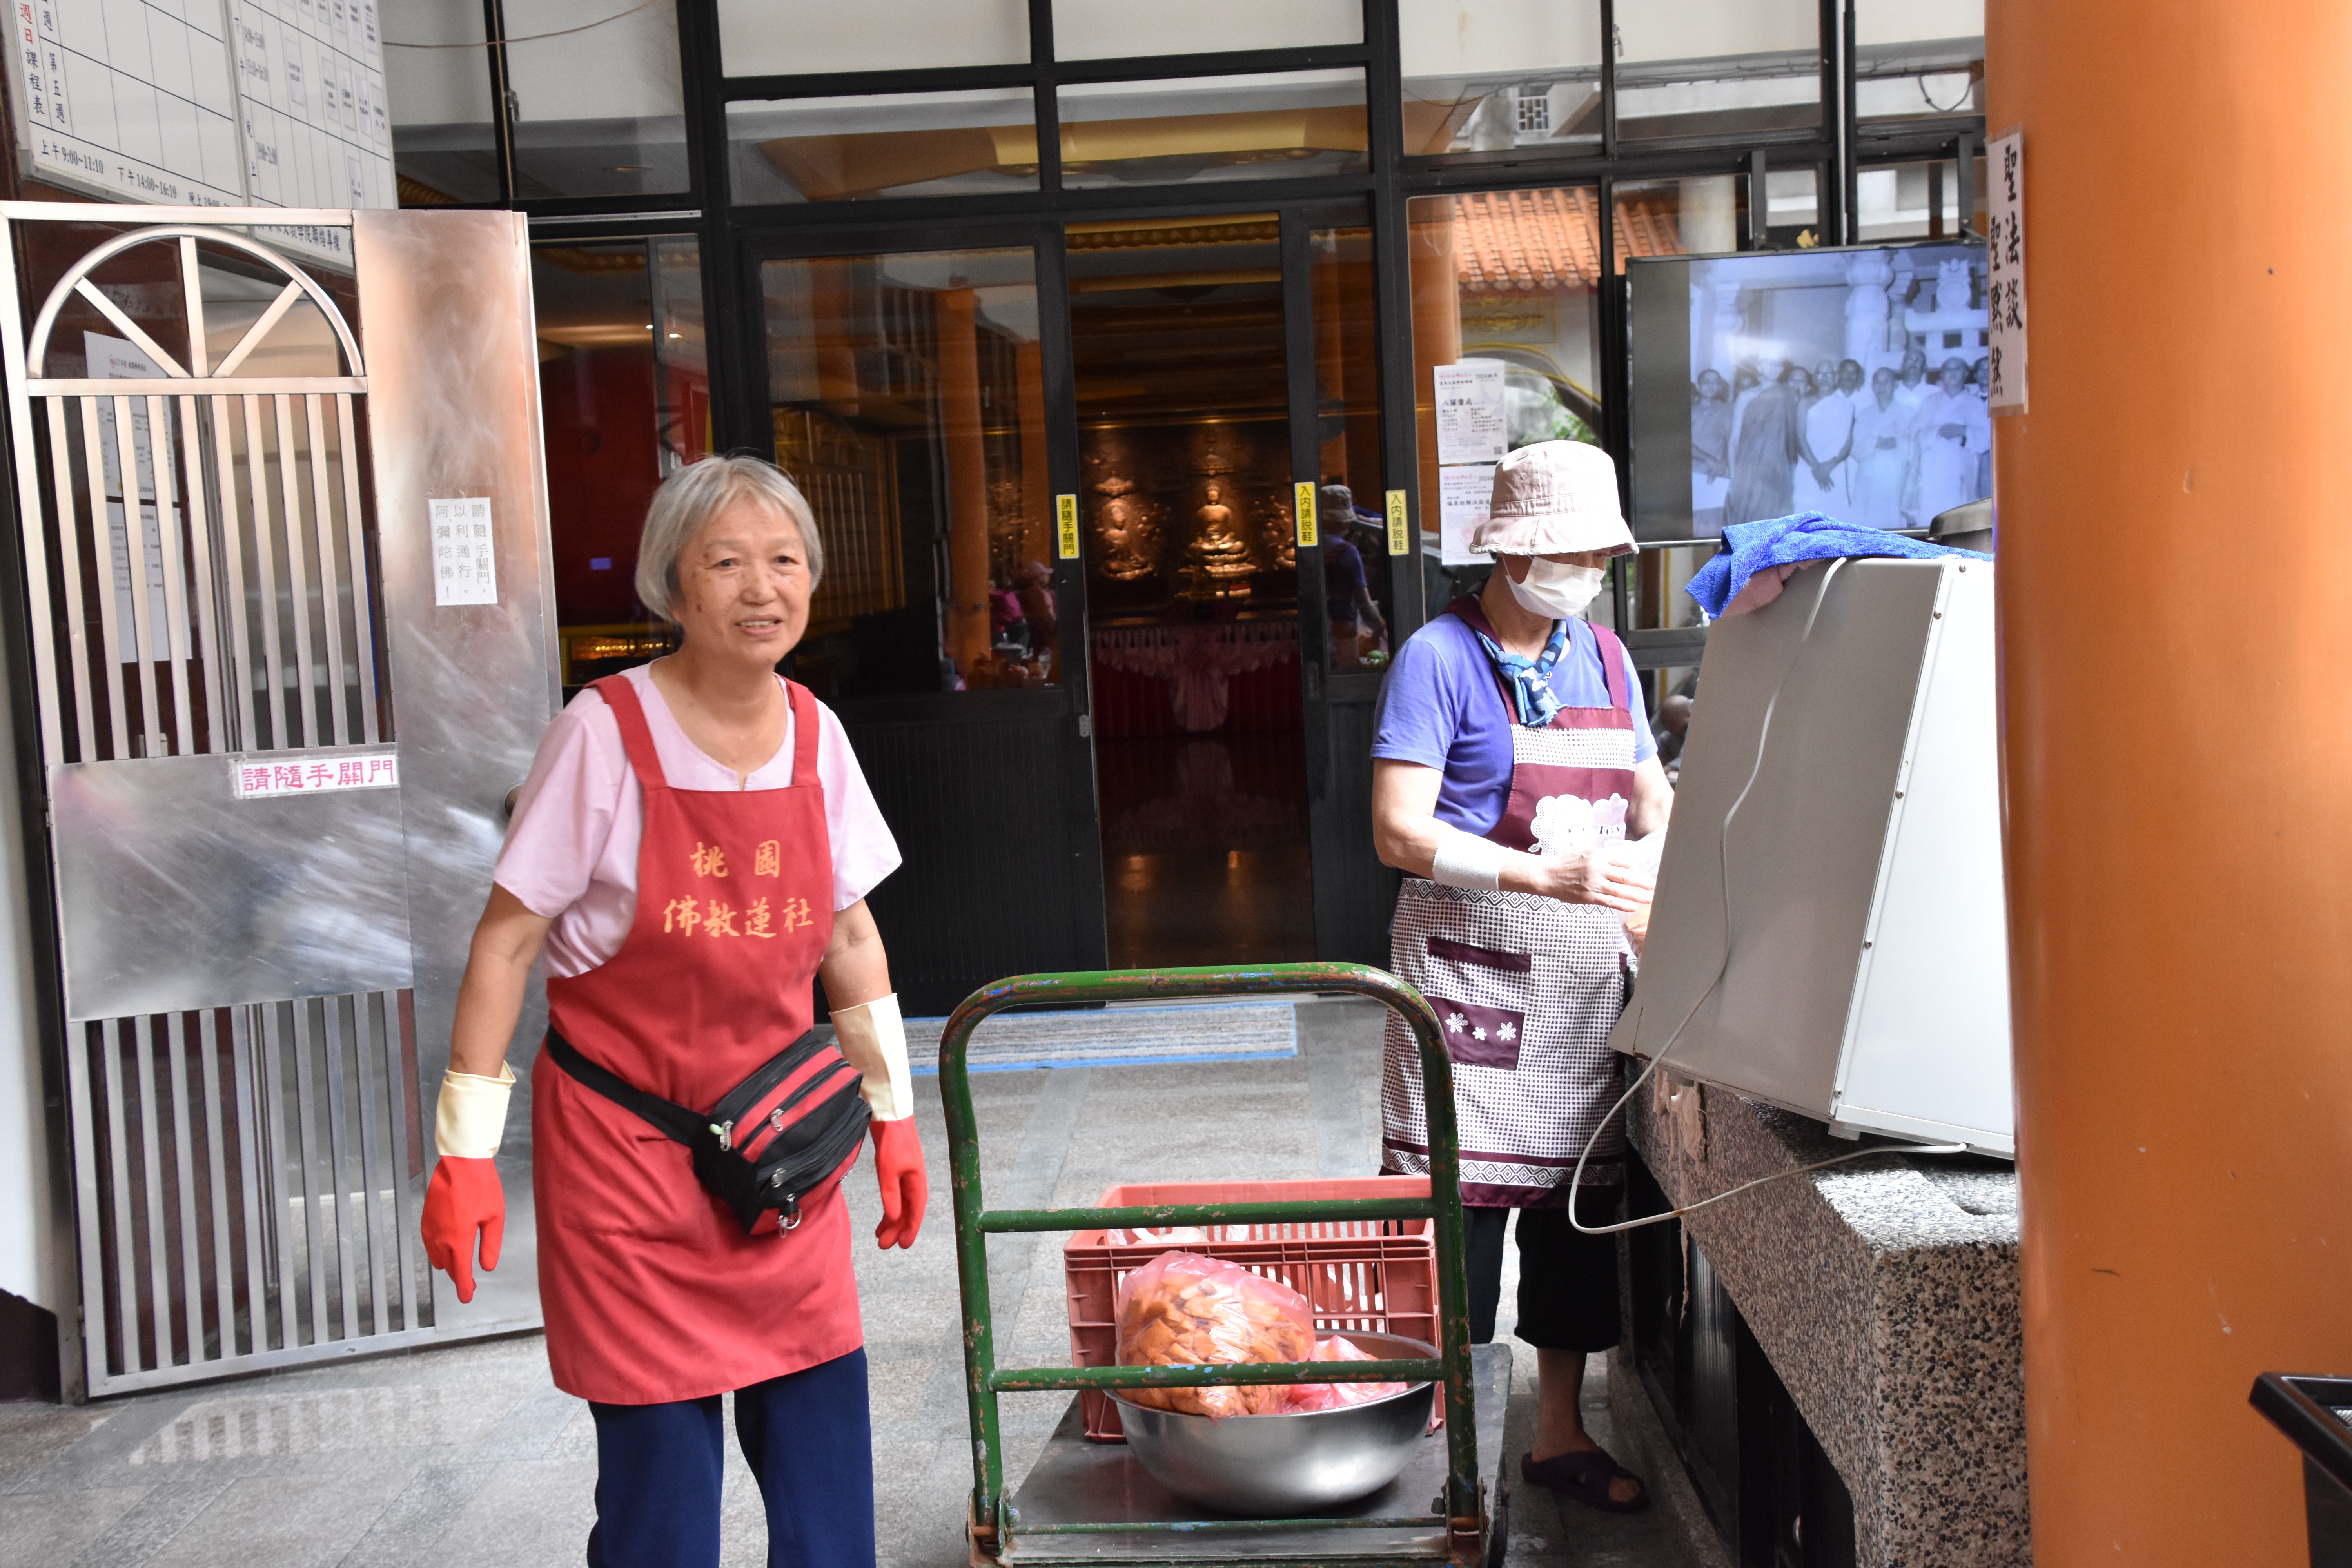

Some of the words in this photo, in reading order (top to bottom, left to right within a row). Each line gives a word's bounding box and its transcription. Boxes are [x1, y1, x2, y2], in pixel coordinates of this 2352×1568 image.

[49, 52, 65, 123] 第五週
[1061, 499, 1074, 555] 請隨手關門
[243, 759, 394, 791] 請隨手關門
[690, 840, 780, 878] 桃園
[663, 895, 814, 938] 佛教蓮社
